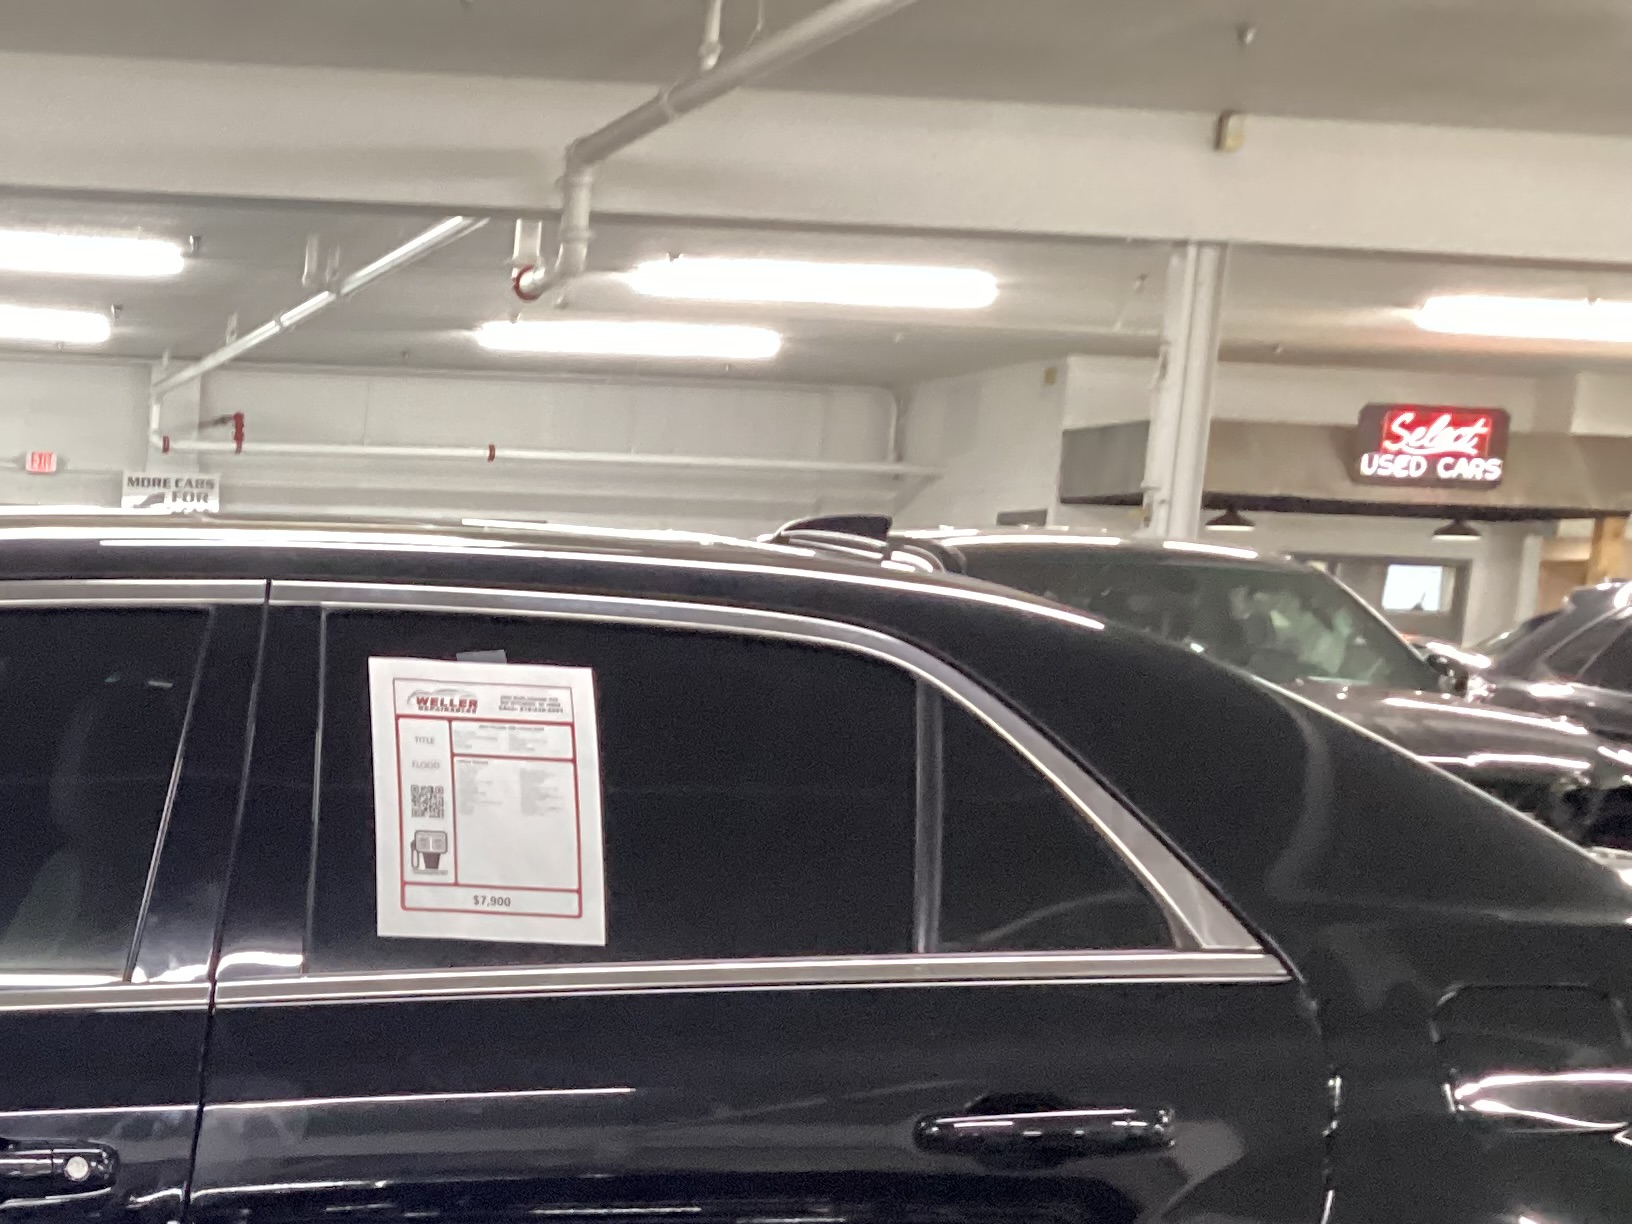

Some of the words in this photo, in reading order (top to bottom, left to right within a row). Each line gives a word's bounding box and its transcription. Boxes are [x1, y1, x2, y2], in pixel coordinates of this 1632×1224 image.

[1384, 411, 1490, 455] Select
[1360, 453, 1428, 478] USED
[1436, 457, 1503, 481] CARS
[127, 476, 171, 489] MORE
[174, 477, 216, 490] CARS
[416, 696, 478, 708] WELLER
[473, 894, 511, 907] $7,900
